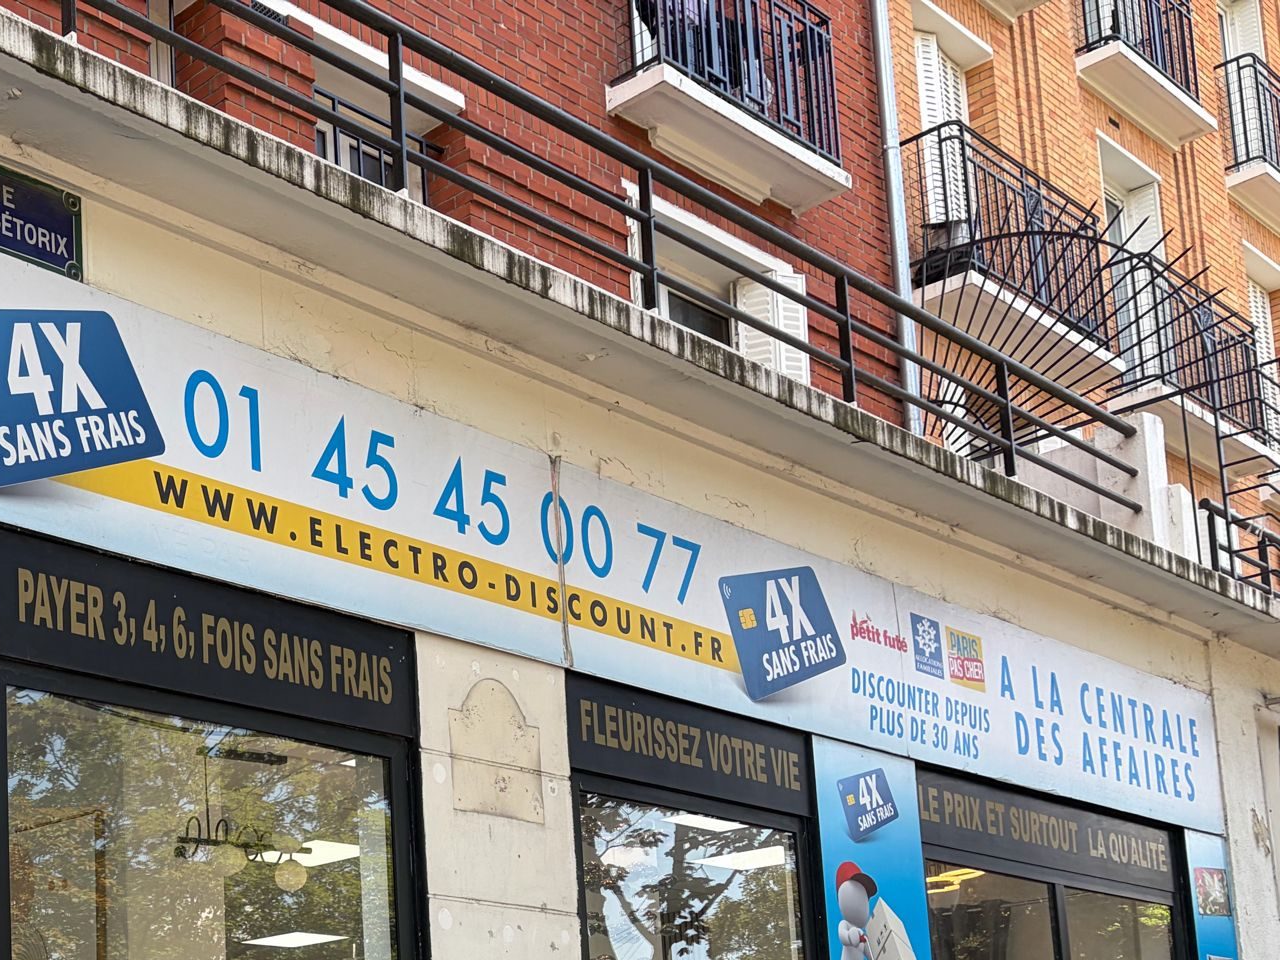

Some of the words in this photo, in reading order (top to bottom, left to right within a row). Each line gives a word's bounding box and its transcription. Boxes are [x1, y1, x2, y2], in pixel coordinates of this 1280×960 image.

[7, 322, 107, 416] 4X
[78, 410, 146, 454] FRAIS
[184, 369, 262, 472] 01
[311, 415, 398, 511] 45
[433, 456, 510, 546] 45
[540, 491, 614, 579] 00
[636, 522, 702, 605] 77
[153, 470, 724, 663] WWW.ELECTRO-DISCOUNT.FR
[17, 568, 106, 641] PAYER
[113, 591, 136, 647] 3,
[143, 600, 166, 654] 4,
[173, 606, 195, 660] 6,
[201, 613, 256, 675] FOIS
[263, 628, 322, 690] SANS
[330, 645, 392, 705] FRAIS
[765, 576, 816, 644] 4X
[883, 630, 908, 653] futé
[762, 642, 800, 682] SANS
[802, 633, 837, 667] FRAIS
[949, 658, 963, 679] PAS
[964, 660, 983, 681] CHER
[950, 632, 978, 659] PARIS
[852, 667, 939, 718] DISCOUNTER
[945, 696, 990, 733] DEPUIS
[870, 704, 904, 738] PLUS
[910, 716, 926, 744] DE
[932, 723, 948, 751] 30
[954, 730, 979, 759] ANS
[1000, 655, 1015, 701] A
[1032, 665, 1064, 716] LA
[1080, 682, 1200, 757] CENTRALE
[579, 700, 703, 769] FLEURISSEZ
[706, 731, 768, 784] VOTRE
[770, 747, 801, 791] VIE
[1014, 711, 1064, 766] DES
[1082, 732, 1195, 802] AFFAIRES
[858, 811, 877, 832] SANS
[876, 802, 895, 822] FRAIS
[859, 774, 884, 811] 4X
[918, 785, 941, 823] LE
[943, 790, 982, 832] PRIX
[985, 799, 1005, 836] ET
[1009, 806, 1078, 853] SURTOUT
[1088, 828, 1107, 859] LA
[1109, 833, 1168, 872] QUALITÉ
